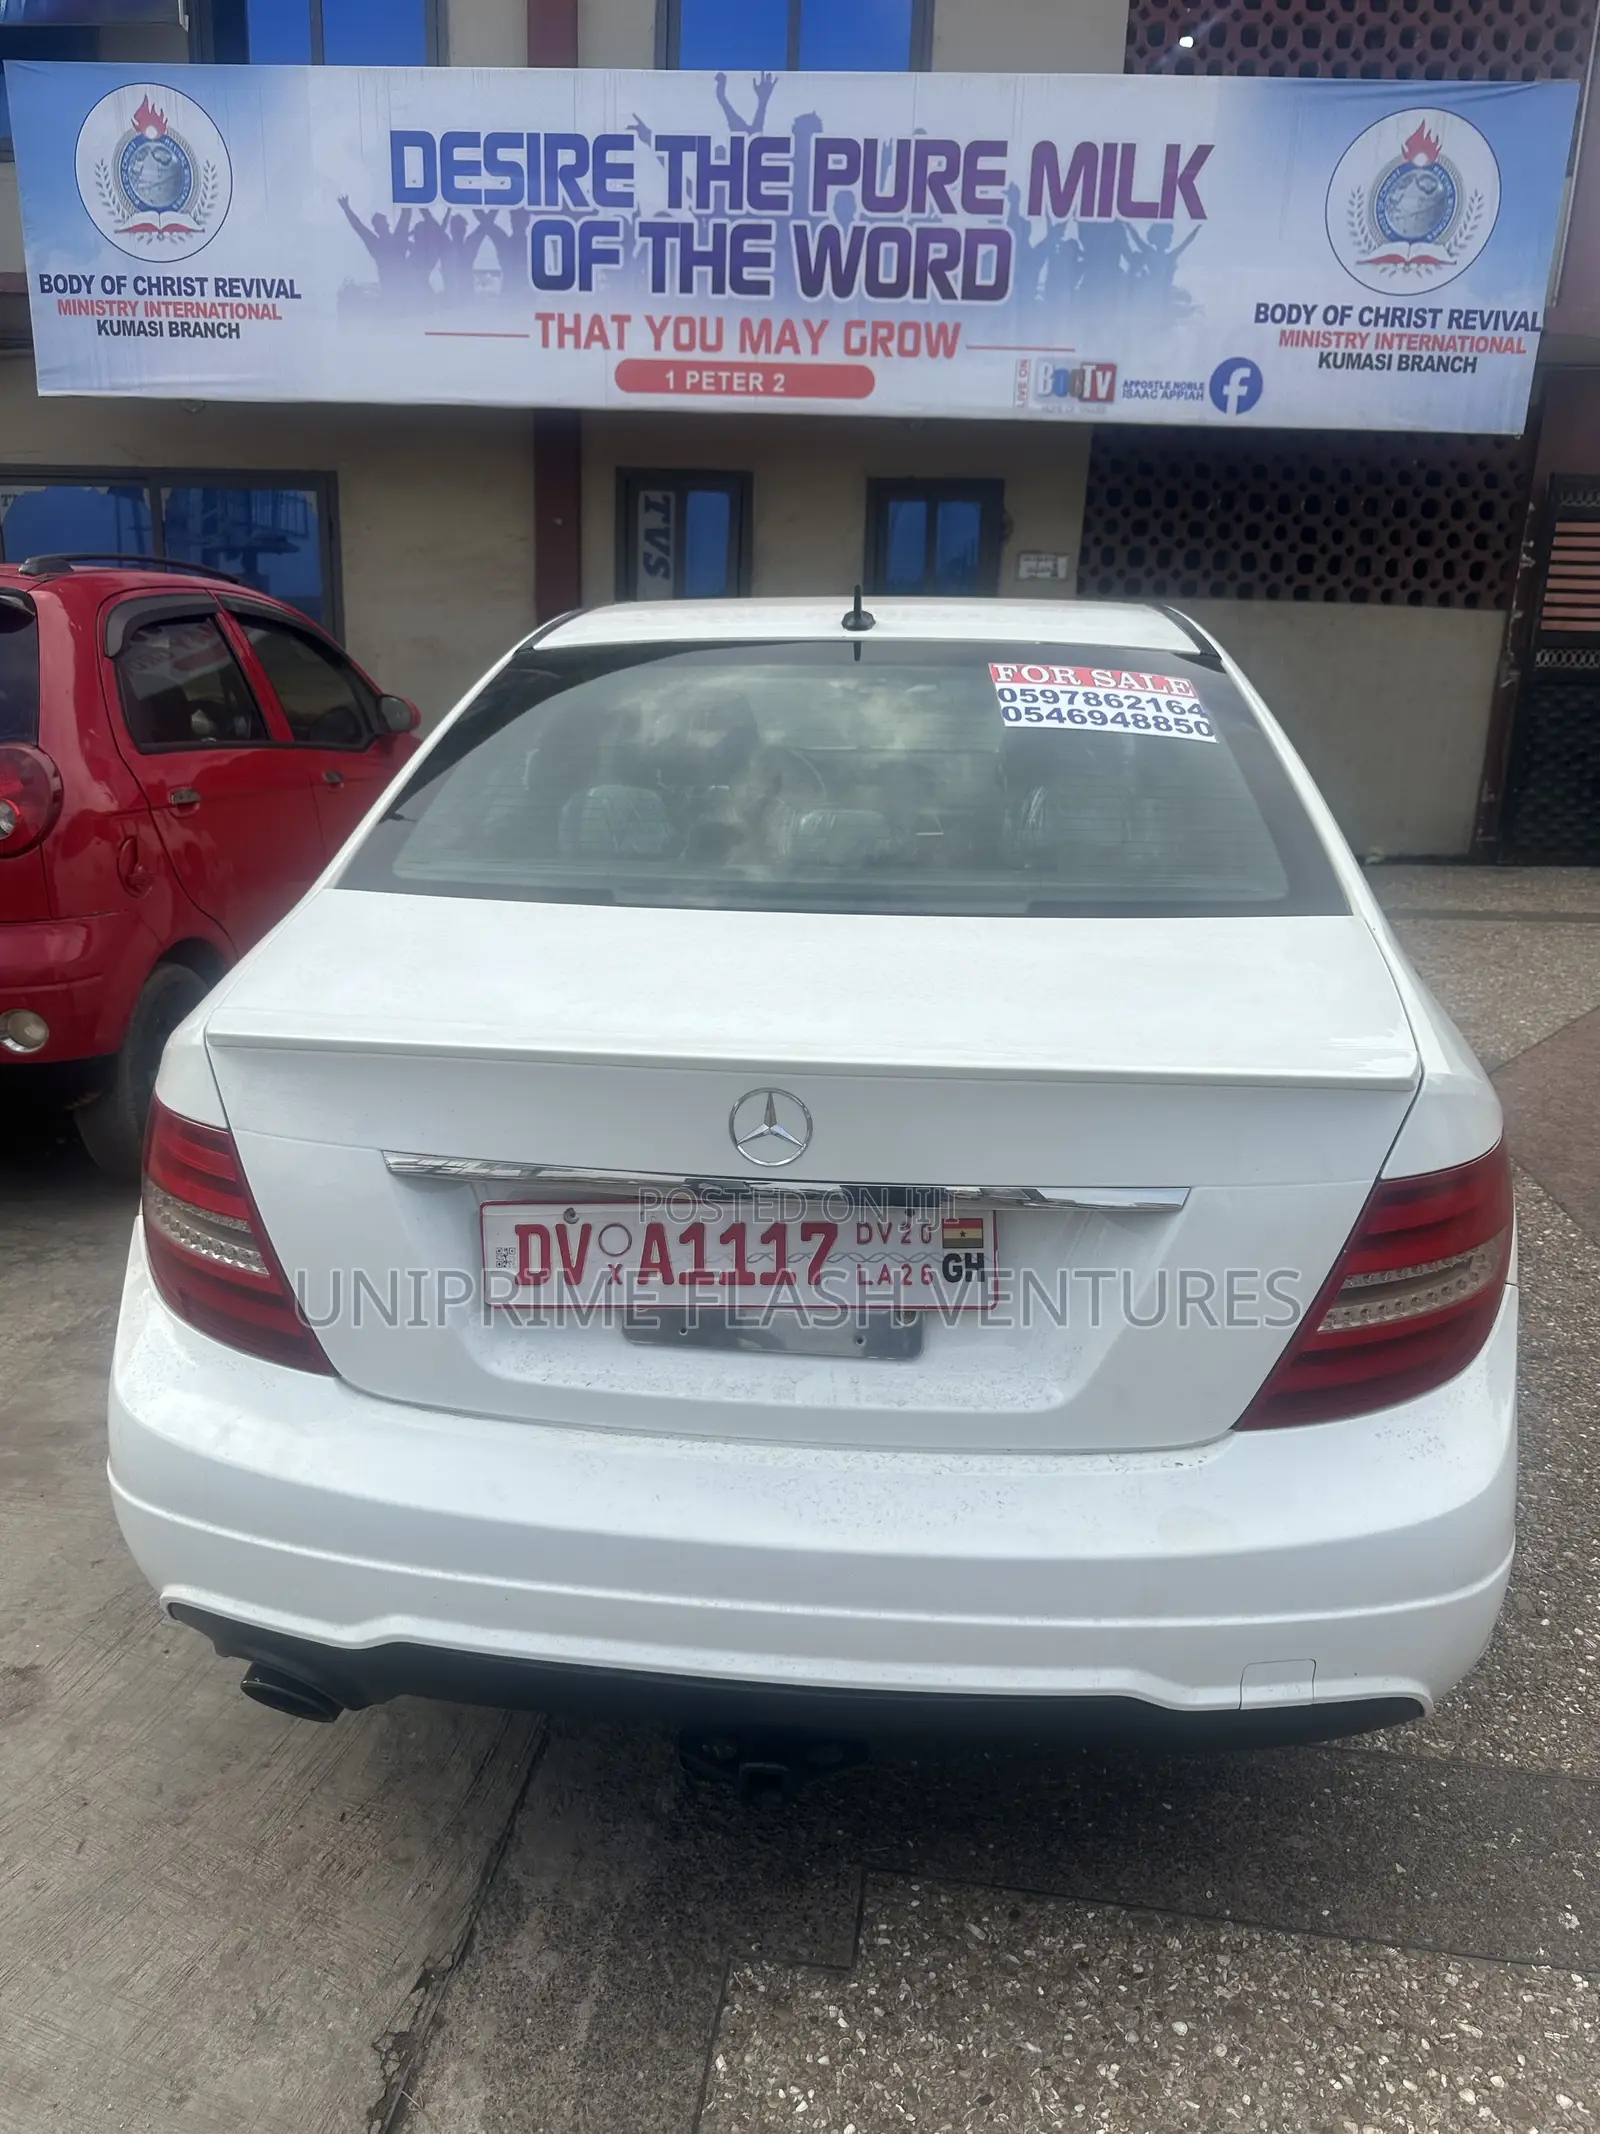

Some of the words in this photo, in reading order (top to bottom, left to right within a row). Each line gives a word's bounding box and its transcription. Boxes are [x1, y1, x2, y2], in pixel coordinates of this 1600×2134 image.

[389, 130, 635, 209] DESIRE
[654, 134, 793, 213] THE
[812, 136, 1009, 216] PURE
[1027, 139, 1216, 221] MILK
[531, 219, 621, 292] OF
[638, 221, 773, 297] THE
[792, 224, 1012, 301] WORD
[38, 273, 95, 295] BODY
[101, 275, 127, 295] OF
[132, 275, 208, 297] CHRIST
[214, 277, 302, 299] REVIVAL
[57, 298, 139, 317] MINISTRY
[144, 300, 283, 320] INTERNATIONAL
[1254, 302, 1317, 325] BODY
[1322, 304, 1353, 327] OF
[1358, 305, 1443, 329] CHRIST
[1447, 308, 1543, 332] REVIVAL
[97, 319, 163, 337] KUMASI
[169, 321, 241, 339] BRANCH
[535, 312, 632, 350] THAT
[643, 315, 724, 353] YOU
[738, 317, 830, 356] MAY
[842, 320, 962, 360] GROW
[1278, 329, 1371, 350] MINISTRY
[1374, 332, 1527, 354] INTERNATIONAL
[1317, 351, 1393, 371] KUMASI
[1397, 353, 1478, 374] BRANCH
[665, 370, 676, 390] 1
[686, 371, 765, 391] PETER
[773, 373, 786, 392] 2
[1122, 389, 1158, 400] ISAAC
[1161, 390, 1205, 401] APPIAH
[1123, 379, 1171, 390] APPOSTLE
[1173, 381, 1205, 391] NOBLE
[643, 493, 671, 580] TVS
[992, 663, 1081, 686] FOR
[1091, 669, 1195, 698] SALE
[998, 687, 1209, 719] 0597862164
[1001, 705, 1216, 738] 0546948850
[514, 1222, 592, 1286] DV
[636, 1222, 839, 1286] A1117
[941, 1252, 986, 1284] GH
